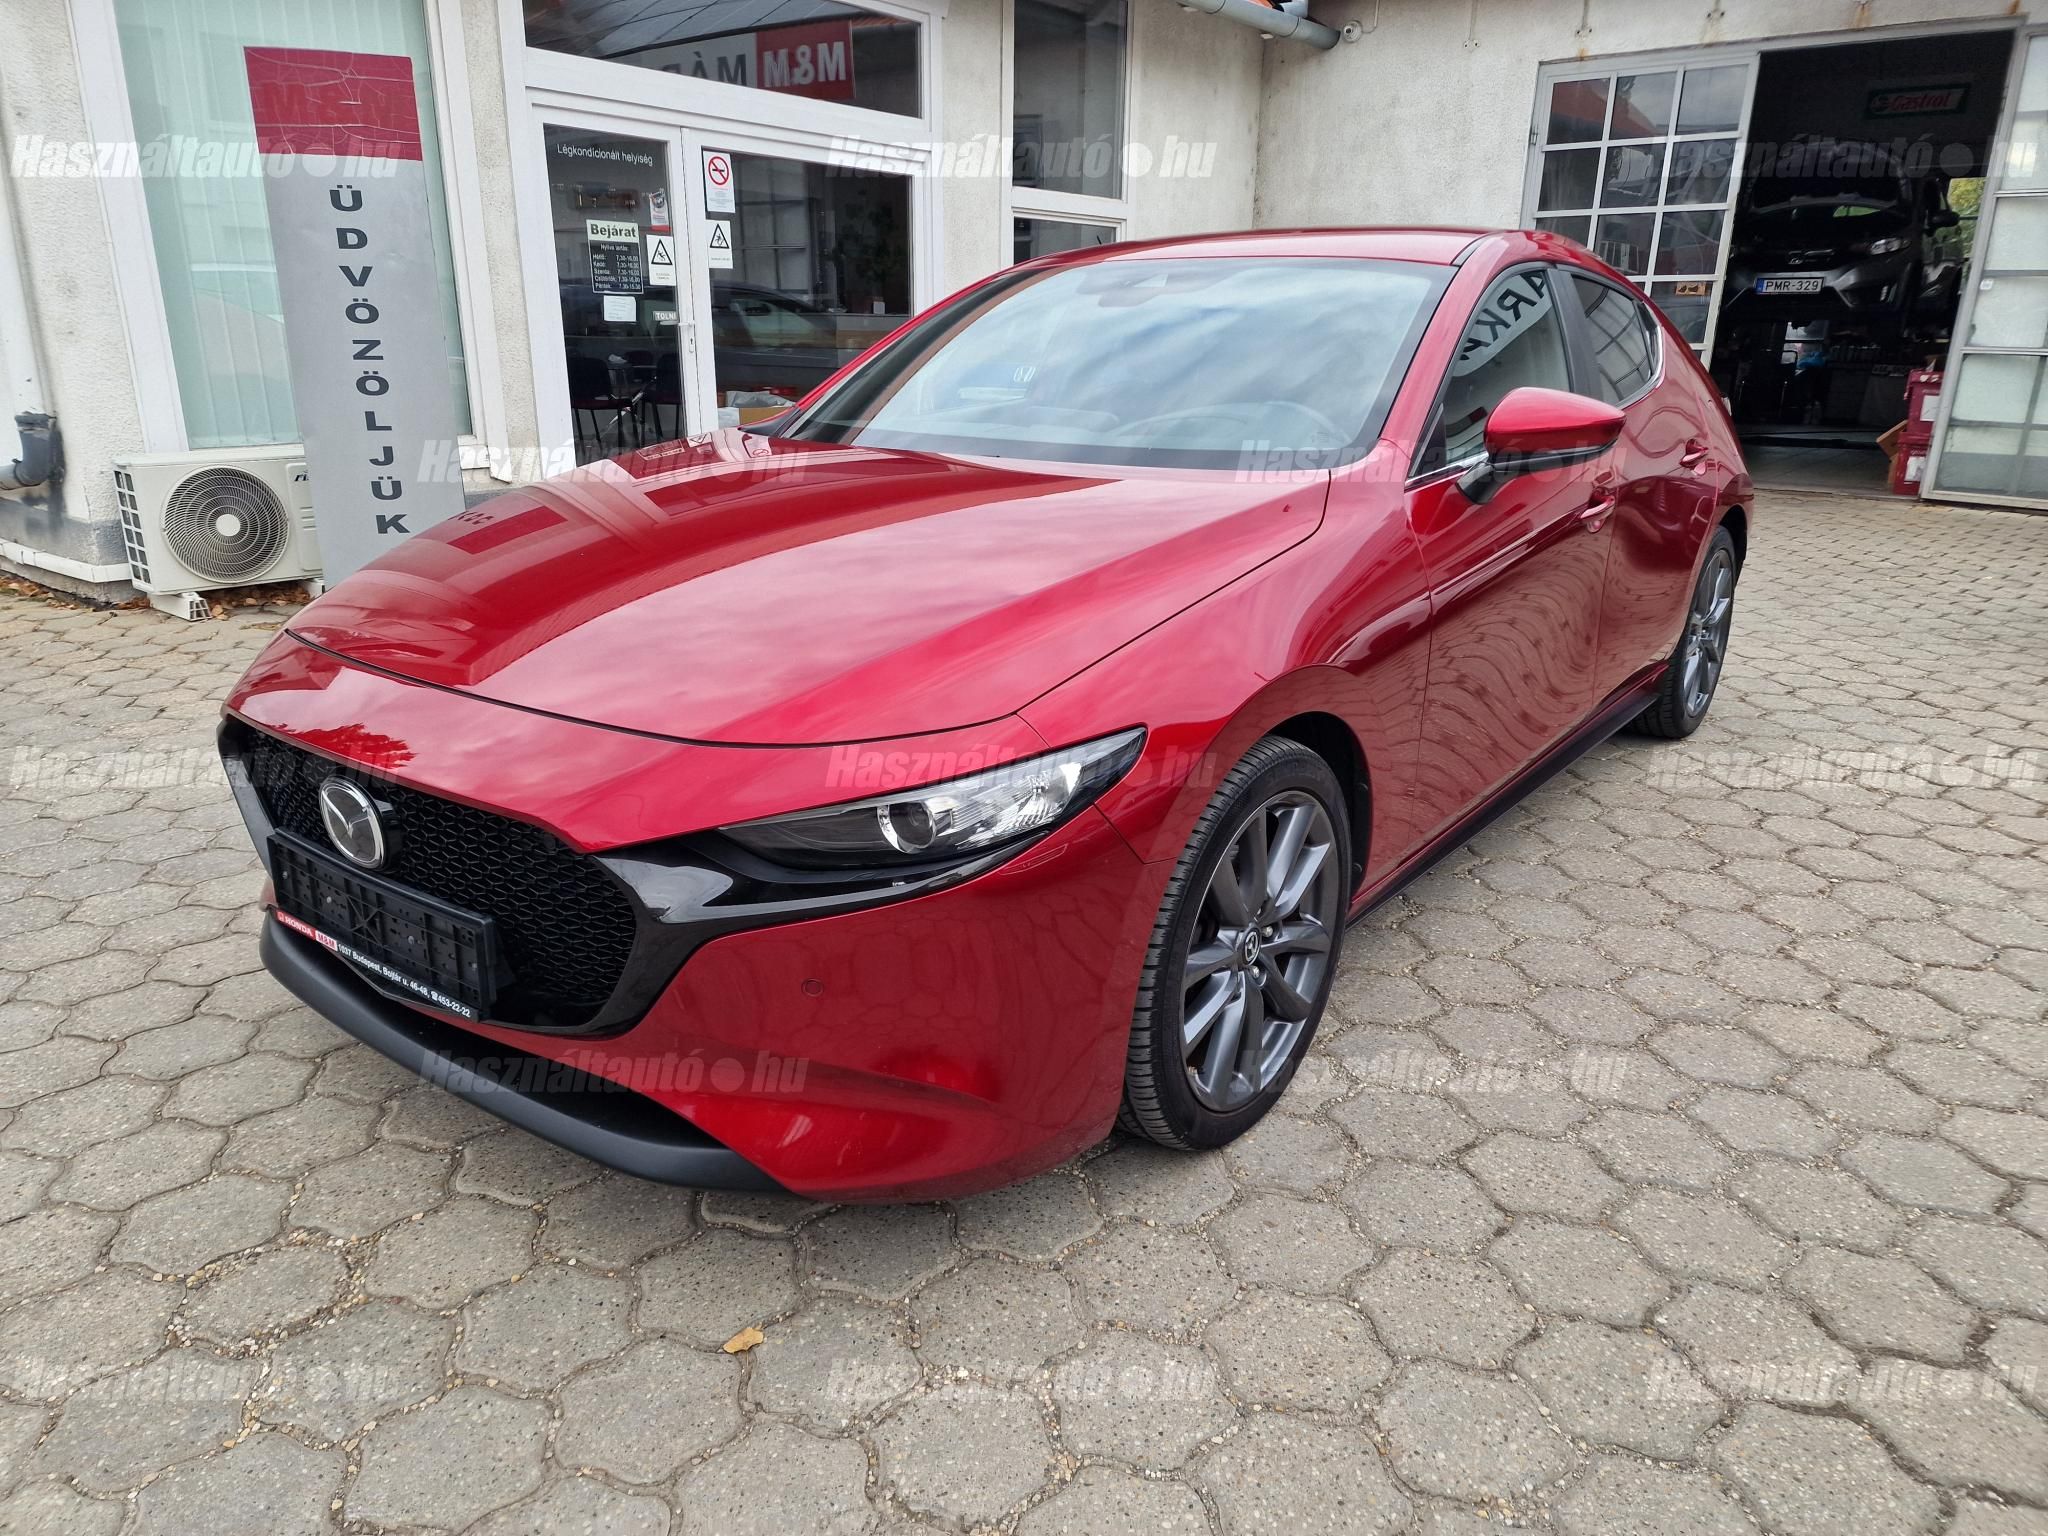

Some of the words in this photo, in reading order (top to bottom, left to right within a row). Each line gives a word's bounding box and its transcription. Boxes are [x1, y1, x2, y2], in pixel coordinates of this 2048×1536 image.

[1892, 92, 1951, 111] Castrol
[622, 150, 653, 167] helyiség
[590, 223, 637, 239] Bejárat
[1765, 279, 1820, 293] PMR-329
[329, 184, 410, 534] ÜDVÖZÖLJÜK
[284, 915, 313, 937] HONDA
[338, 943, 352, 957] 1037
[352, 951, 382, 974] Budapest,
